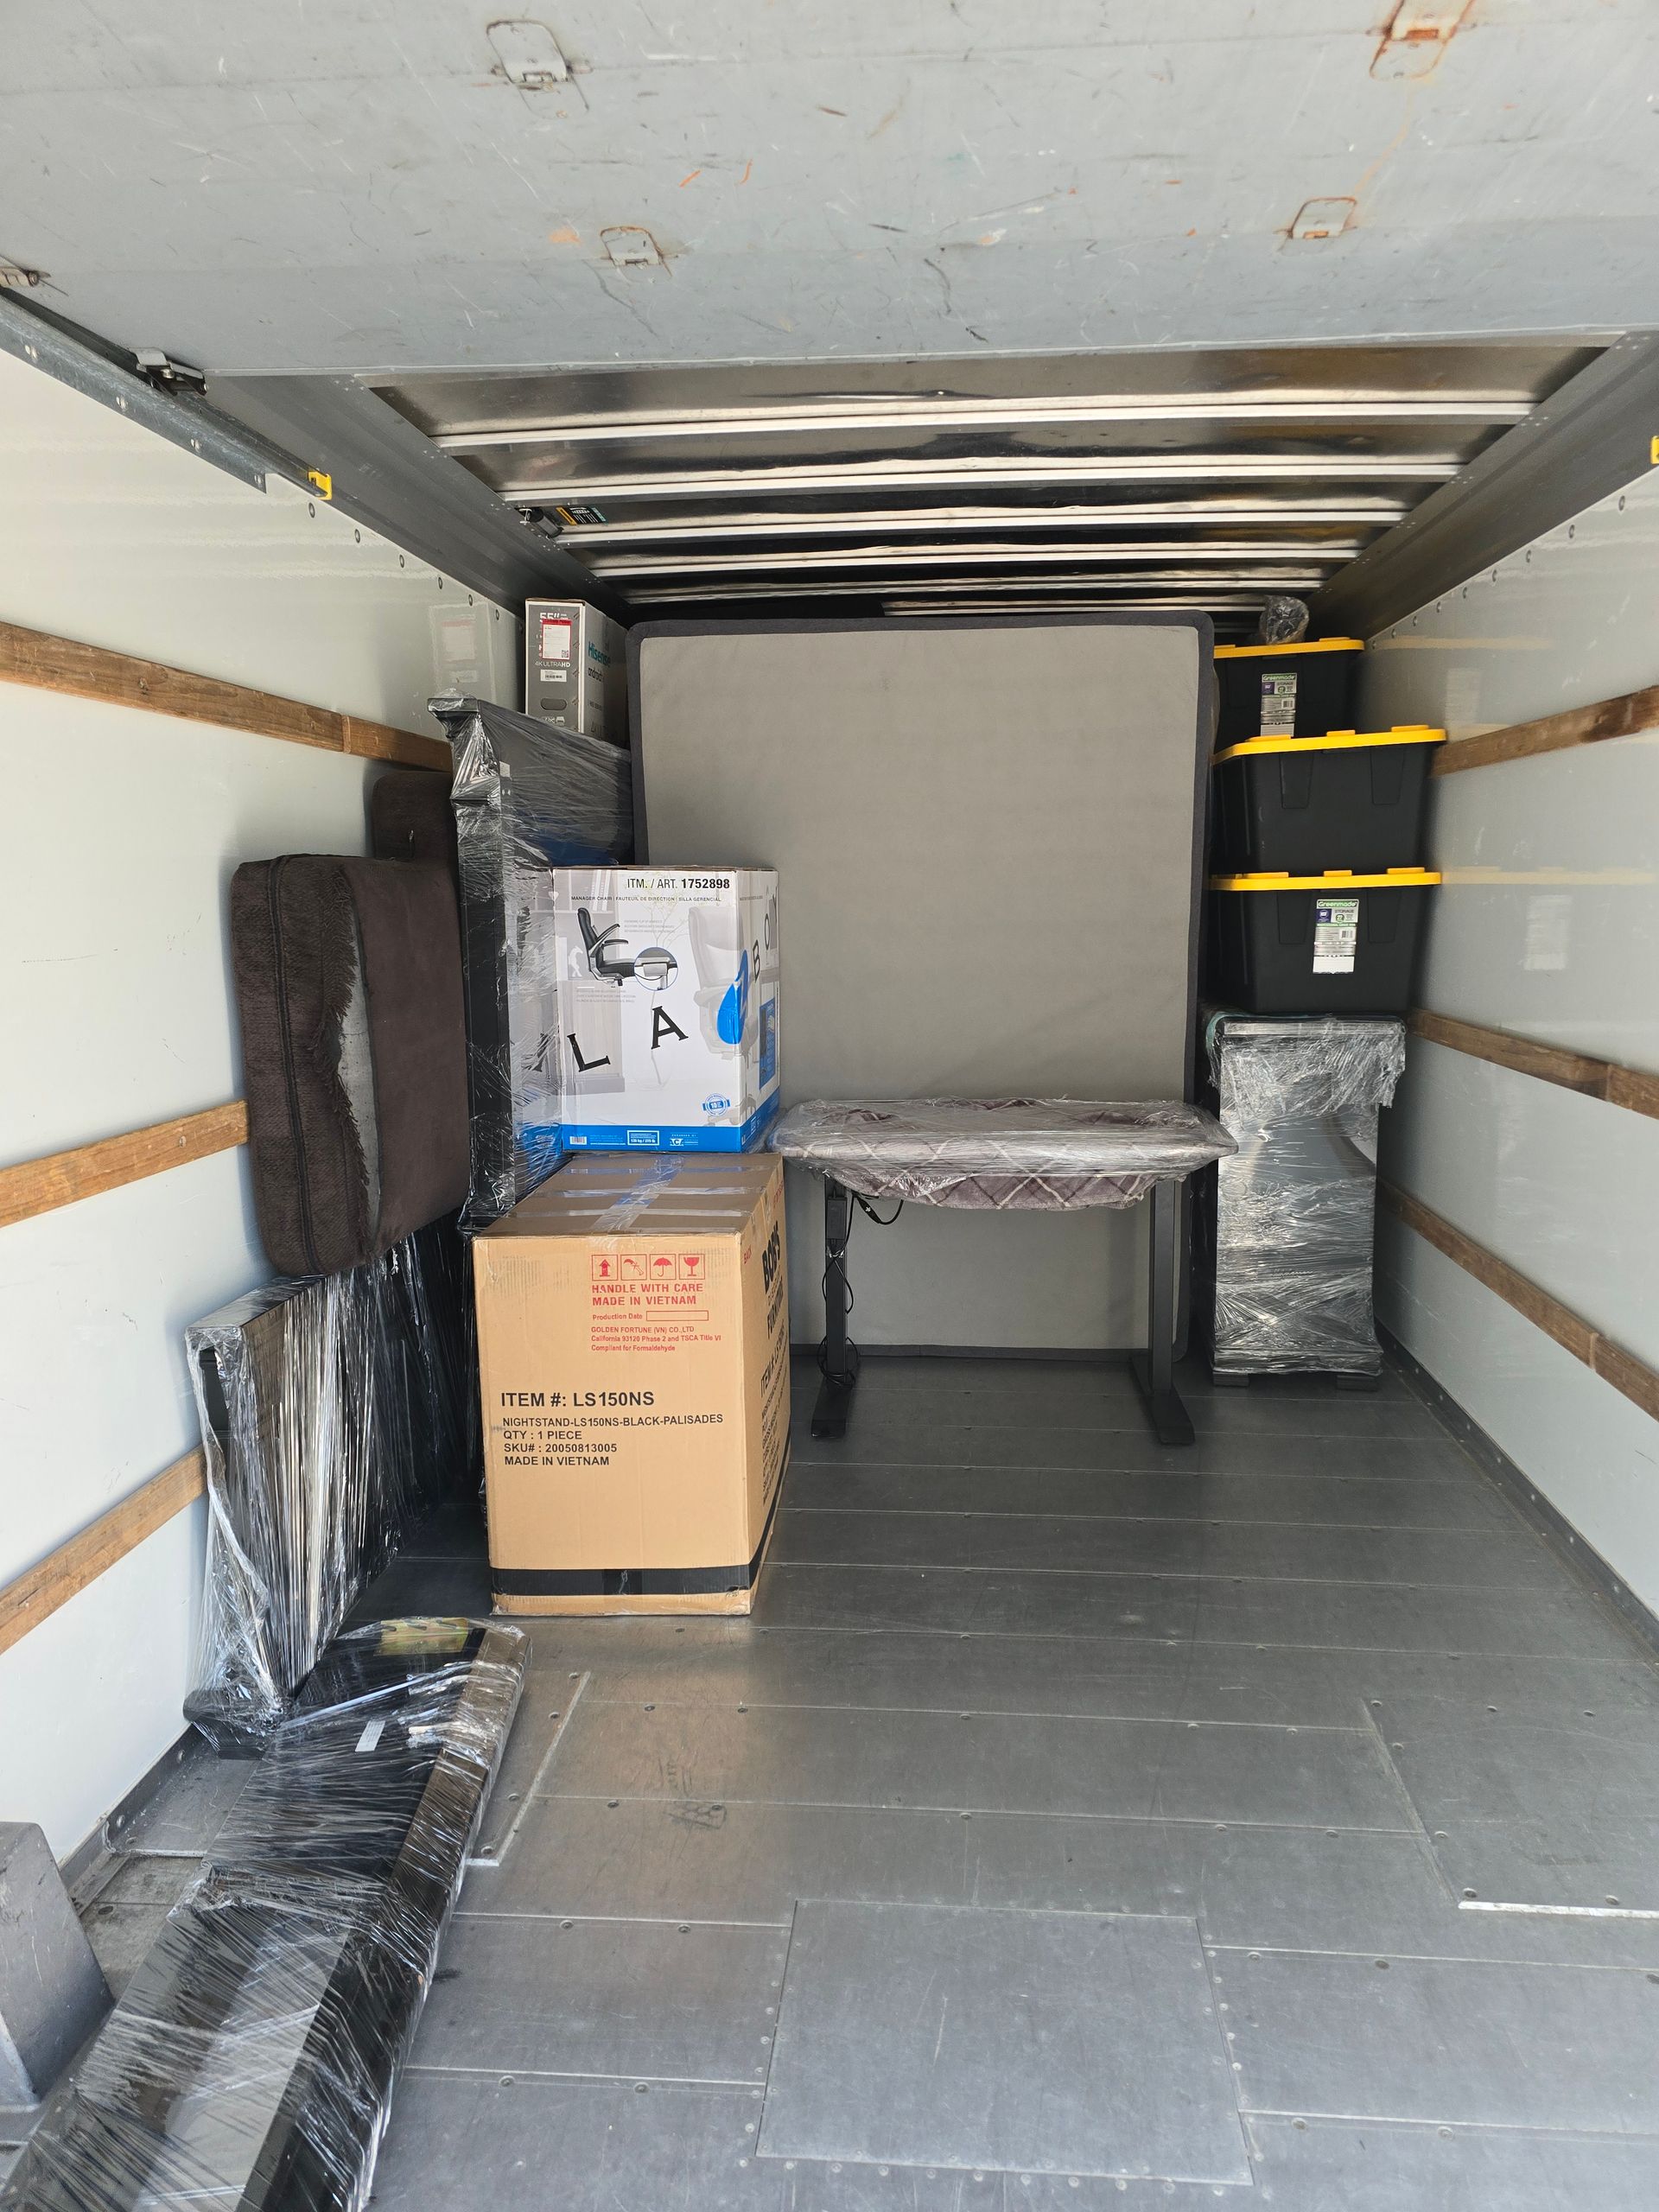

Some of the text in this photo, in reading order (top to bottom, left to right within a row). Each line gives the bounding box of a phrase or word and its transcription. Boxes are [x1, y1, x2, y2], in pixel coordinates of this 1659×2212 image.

[627, 878, 731, 889] ITM. / ART. 1752898
[592, 1283, 704, 1294] HANDLE WITH CARE
[592, 1295, 696, 1306] MADE IN VIETNAM
[501, 1391, 655, 1408] ITEM #: LS150NS
[503, 1414, 724, 1427] NIGHTSTAND-LS150NS-BLACK-PALISADES
[503, 1431, 527, 1440] QTY
[537, 1431, 543, 1440] 1
[547, 1430, 582, 1440] PIECE
[504, 1444, 535, 1452] SKU#
[545, 1443, 618, 1452] 20050813005
[505, 1456, 610, 1465] MADE IN VIETNAM
